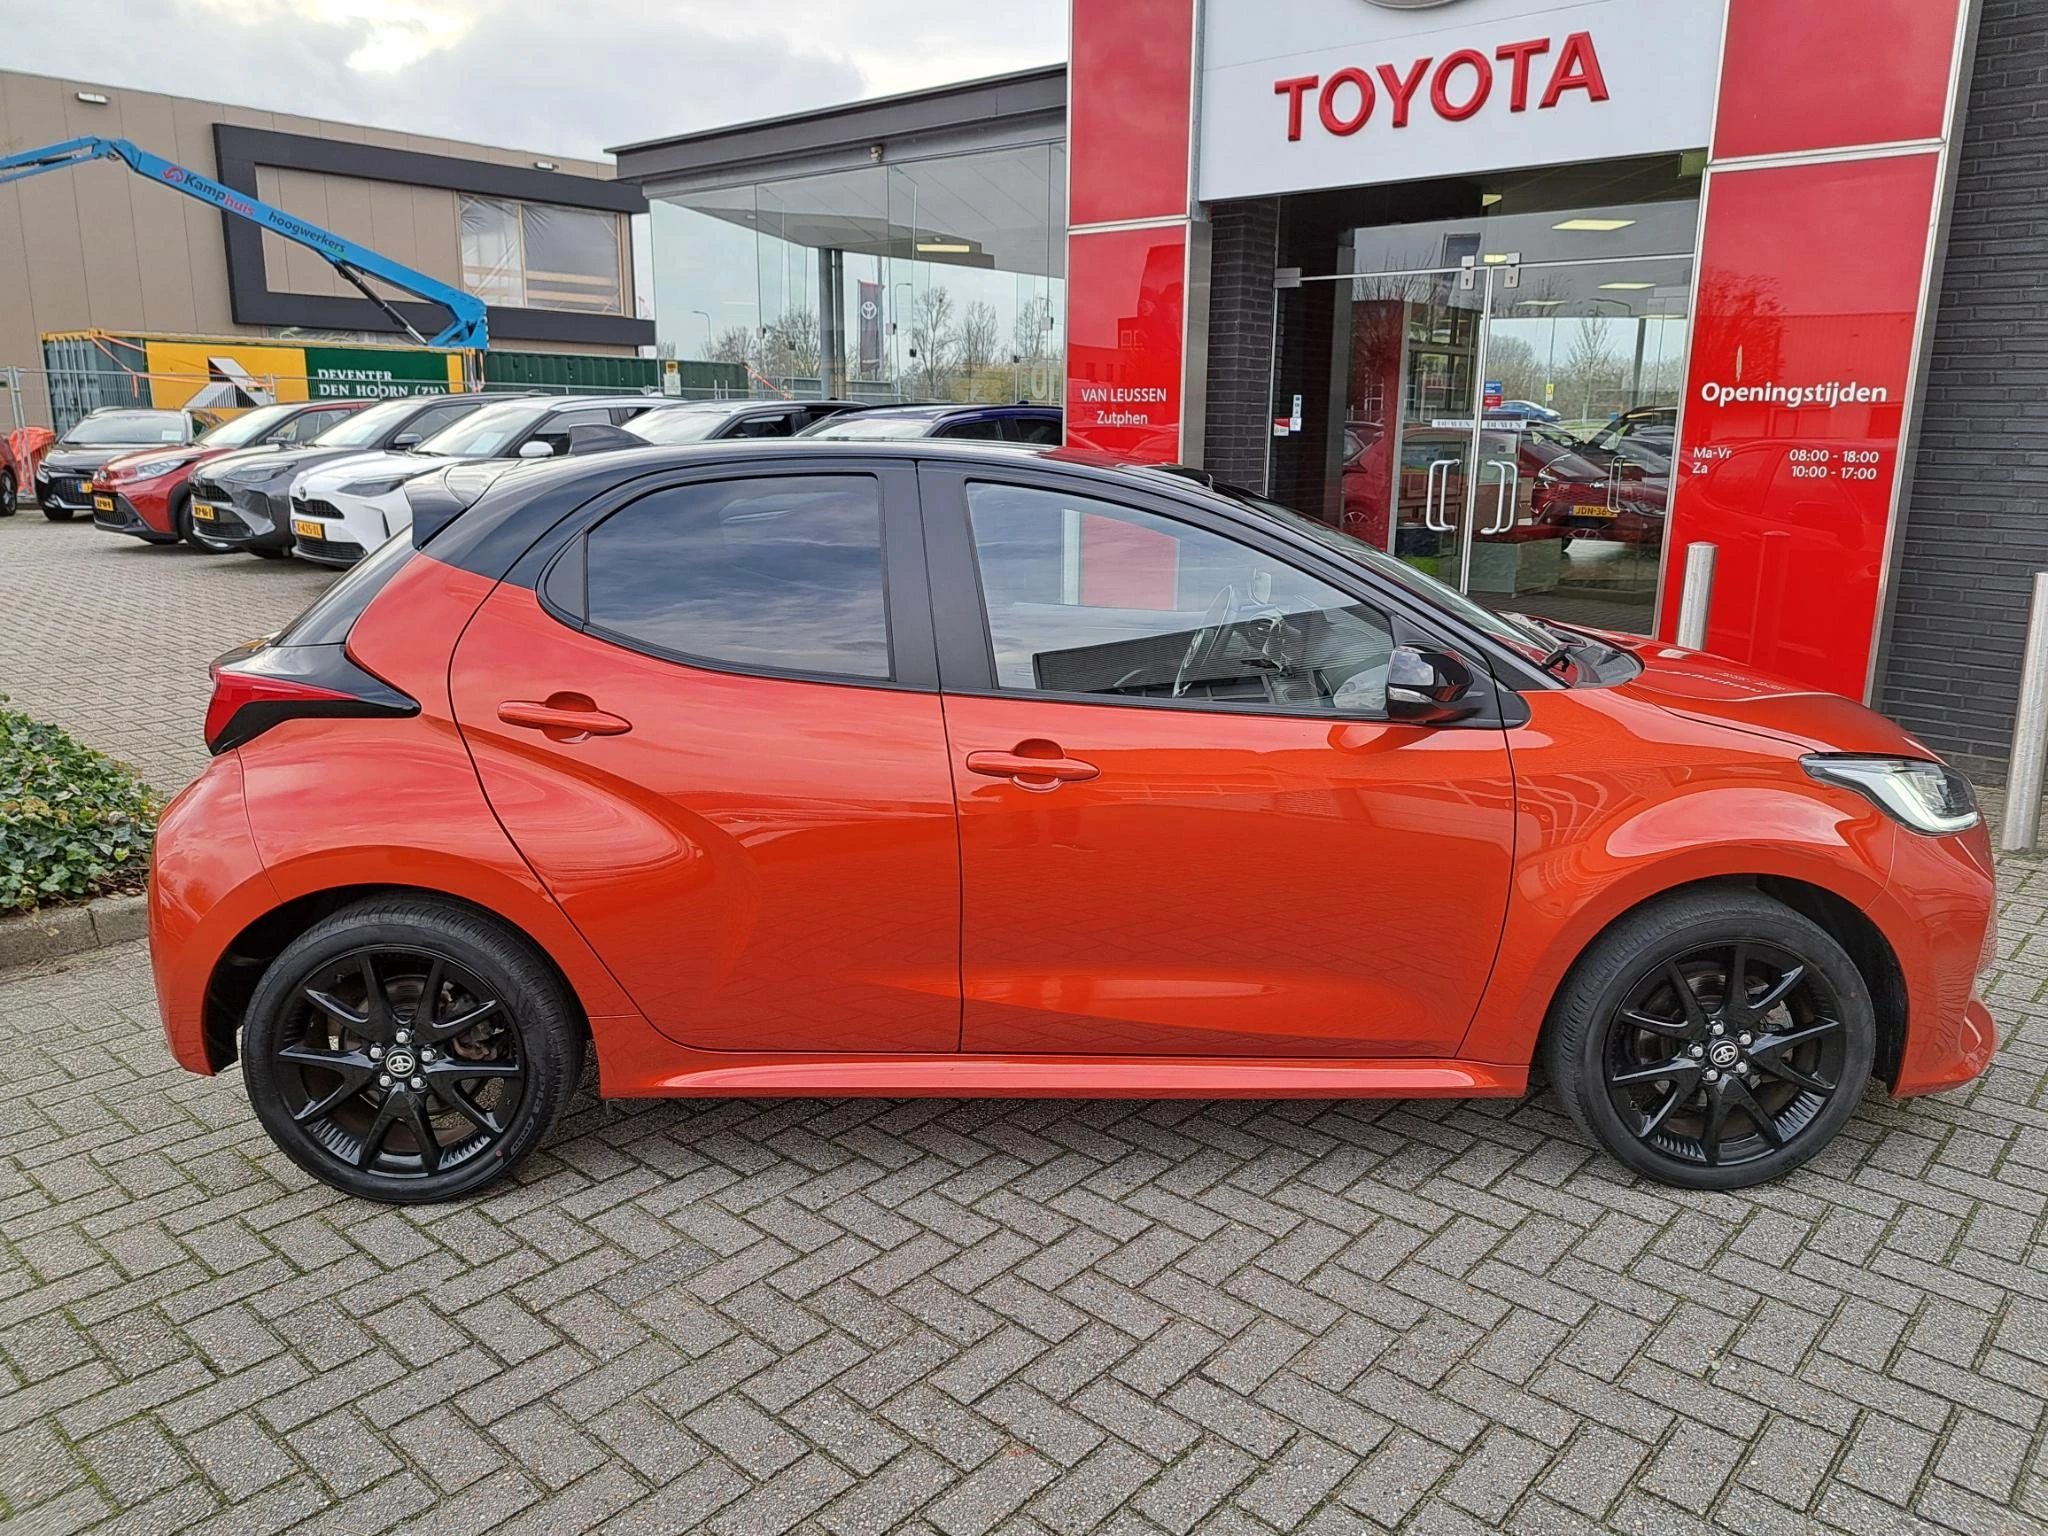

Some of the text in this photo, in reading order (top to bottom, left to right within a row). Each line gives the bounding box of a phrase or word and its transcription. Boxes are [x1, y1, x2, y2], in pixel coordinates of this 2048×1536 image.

[1274, 31, 1610, 142] TOYOTA
[183, 173, 345, 253] Kamphuis hoogwerkers
[317, 368, 393, 381] DEVENTER
[319, 383, 349, 396] DEN
[356, 384, 409, 397] HOORN
[1081, 388, 1167, 402] VAN LEUSSEN
[1701, 381, 1887, 407] Openingstijden
[1096, 410, 1148, 428] Zutphen
[1693, 447, 1732, 459] Ma-Vr
[1789, 449, 1829, 462] 08:00
[1843, 450, 1880, 464] 18:00
[1692, 463, 1708, 474] Za
[1791, 466, 1828, 478] 10:00
[1841, 466, 1877, 480] 17:00
